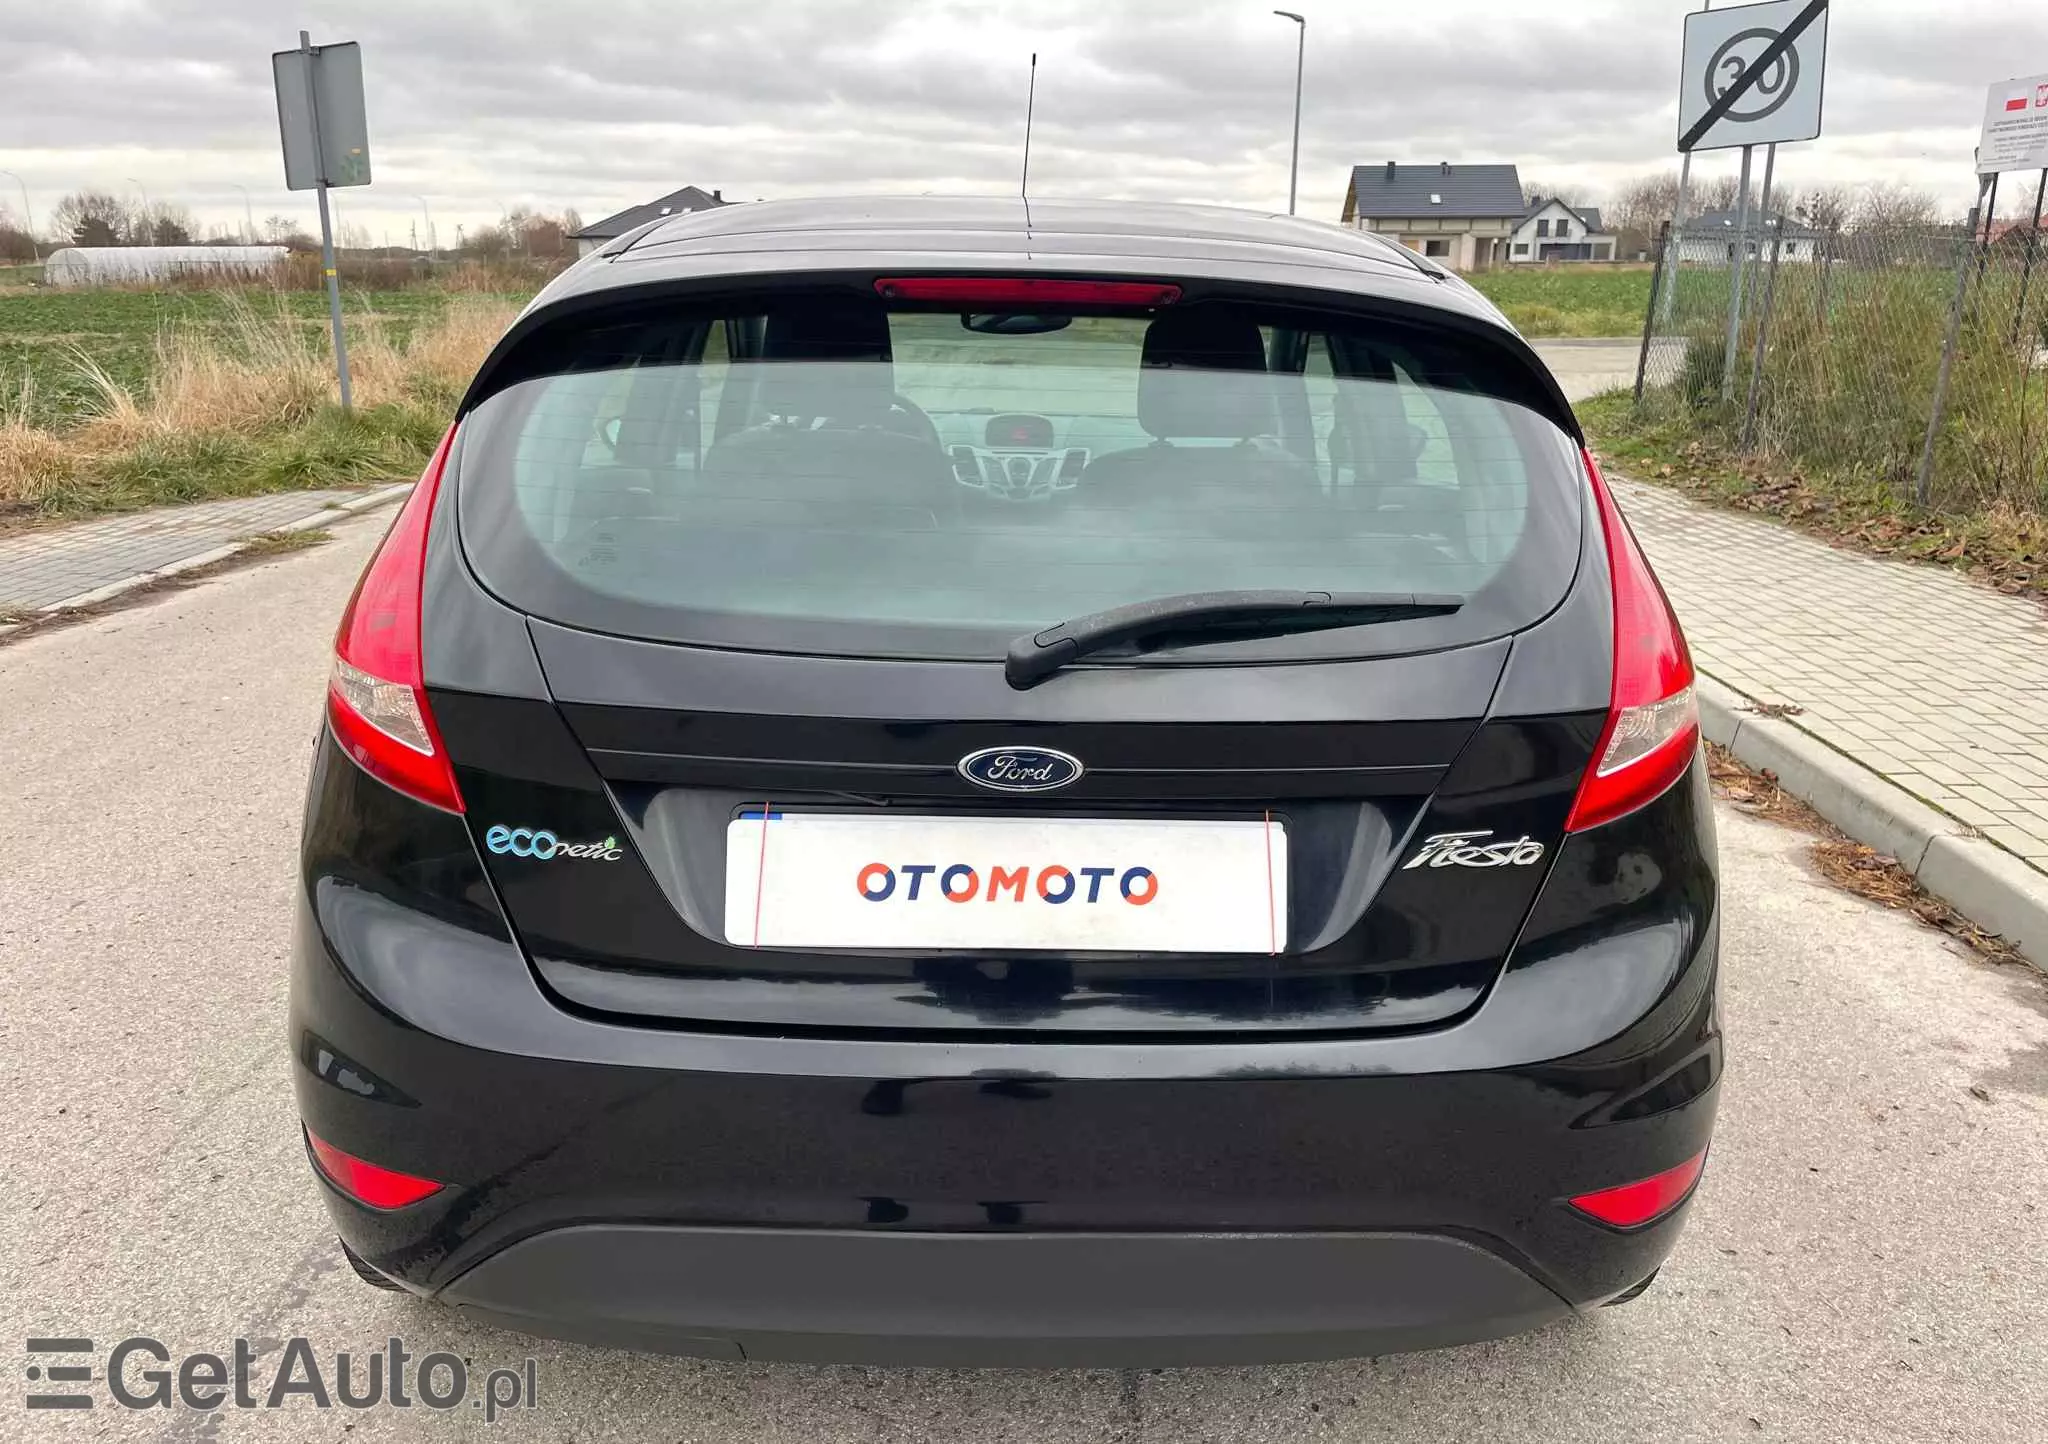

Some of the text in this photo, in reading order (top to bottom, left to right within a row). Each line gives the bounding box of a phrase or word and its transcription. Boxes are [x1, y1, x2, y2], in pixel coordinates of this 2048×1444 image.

[987, 755, 1053, 781] Ford
[1402, 830, 1544, 870] Fiesta
[856, 862, 1159, 906] OTOMOTO
